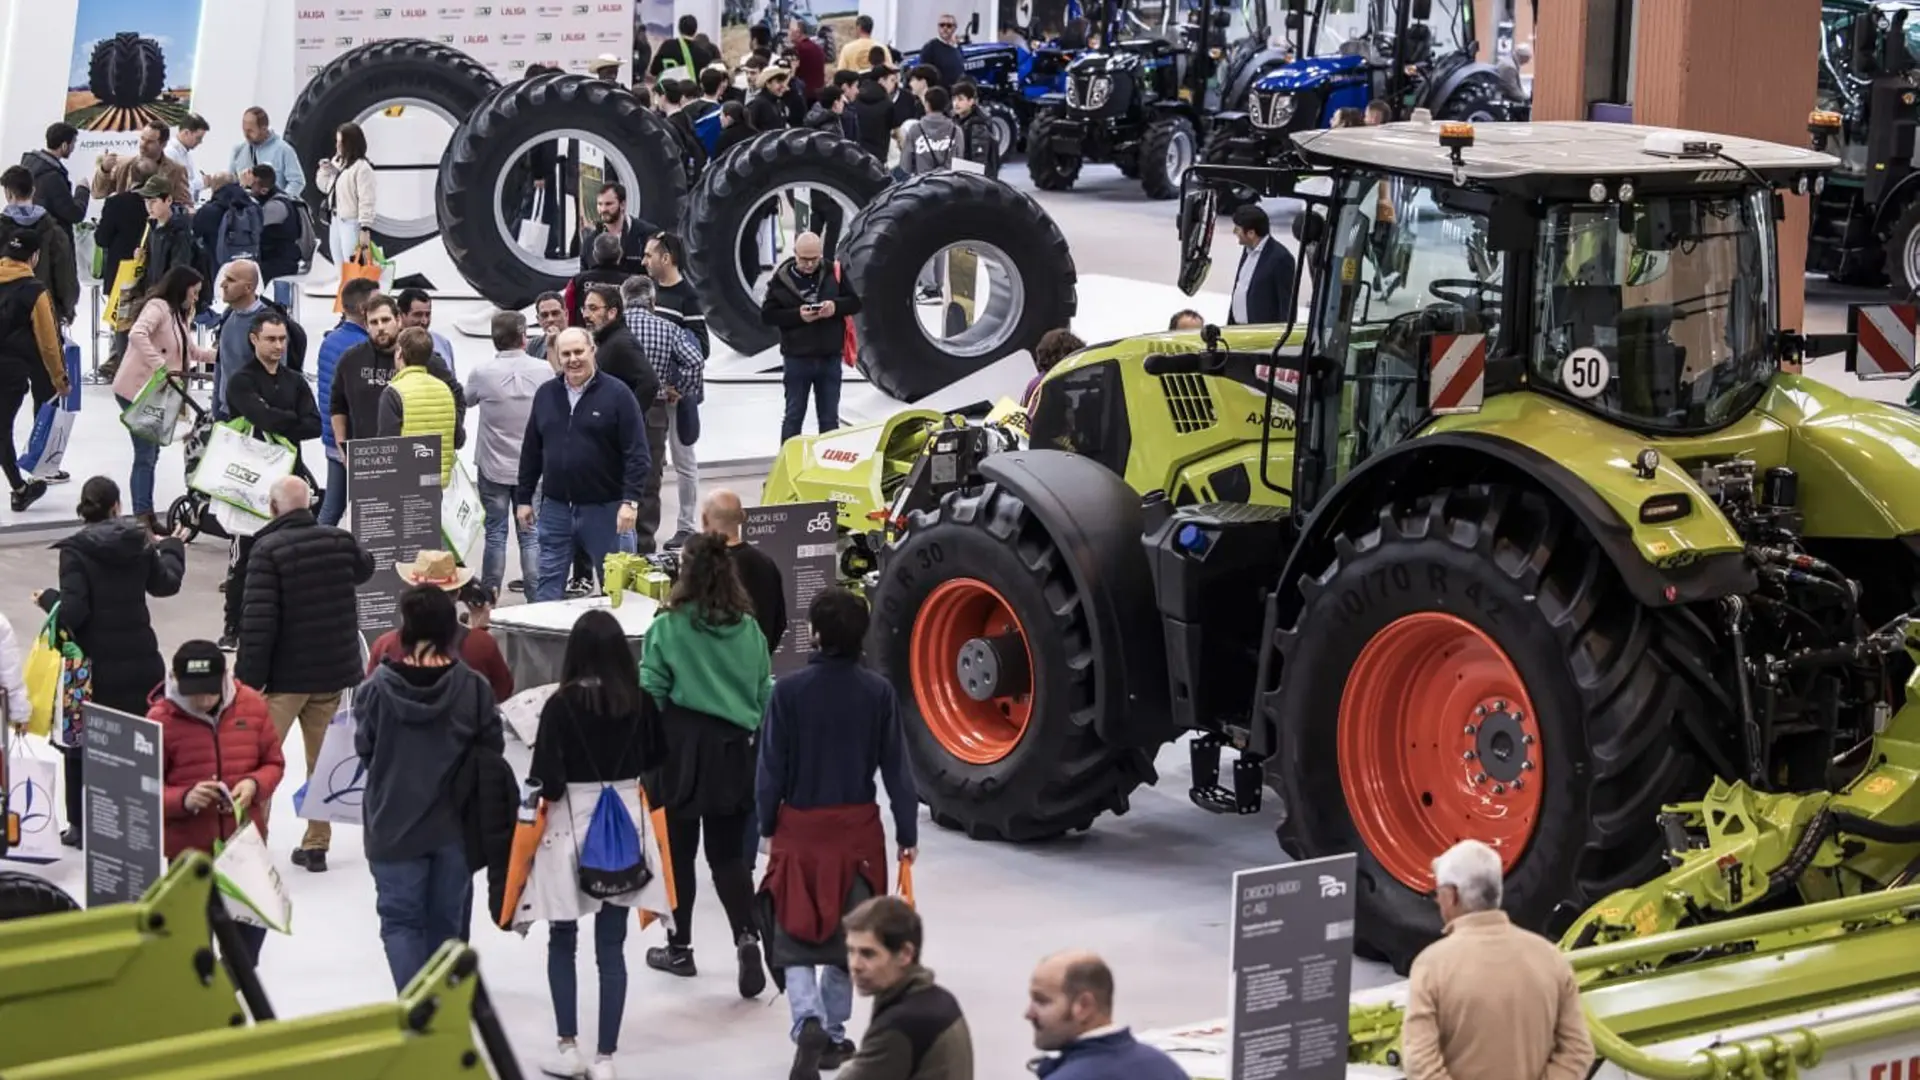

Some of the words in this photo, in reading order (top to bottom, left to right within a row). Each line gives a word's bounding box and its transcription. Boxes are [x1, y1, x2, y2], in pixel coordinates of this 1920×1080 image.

[298, 10, 325, 19] LALIGA
[501, 7, 526, 16] LALIGA
[1695, 169, 1746, 182] CLAAS
[1572, 357, 1600, 388] 50
[822, 449, 860, 463] CLAAS
[917, 542, 944, 569] 30
[1427, 563, 1448, 593] R
